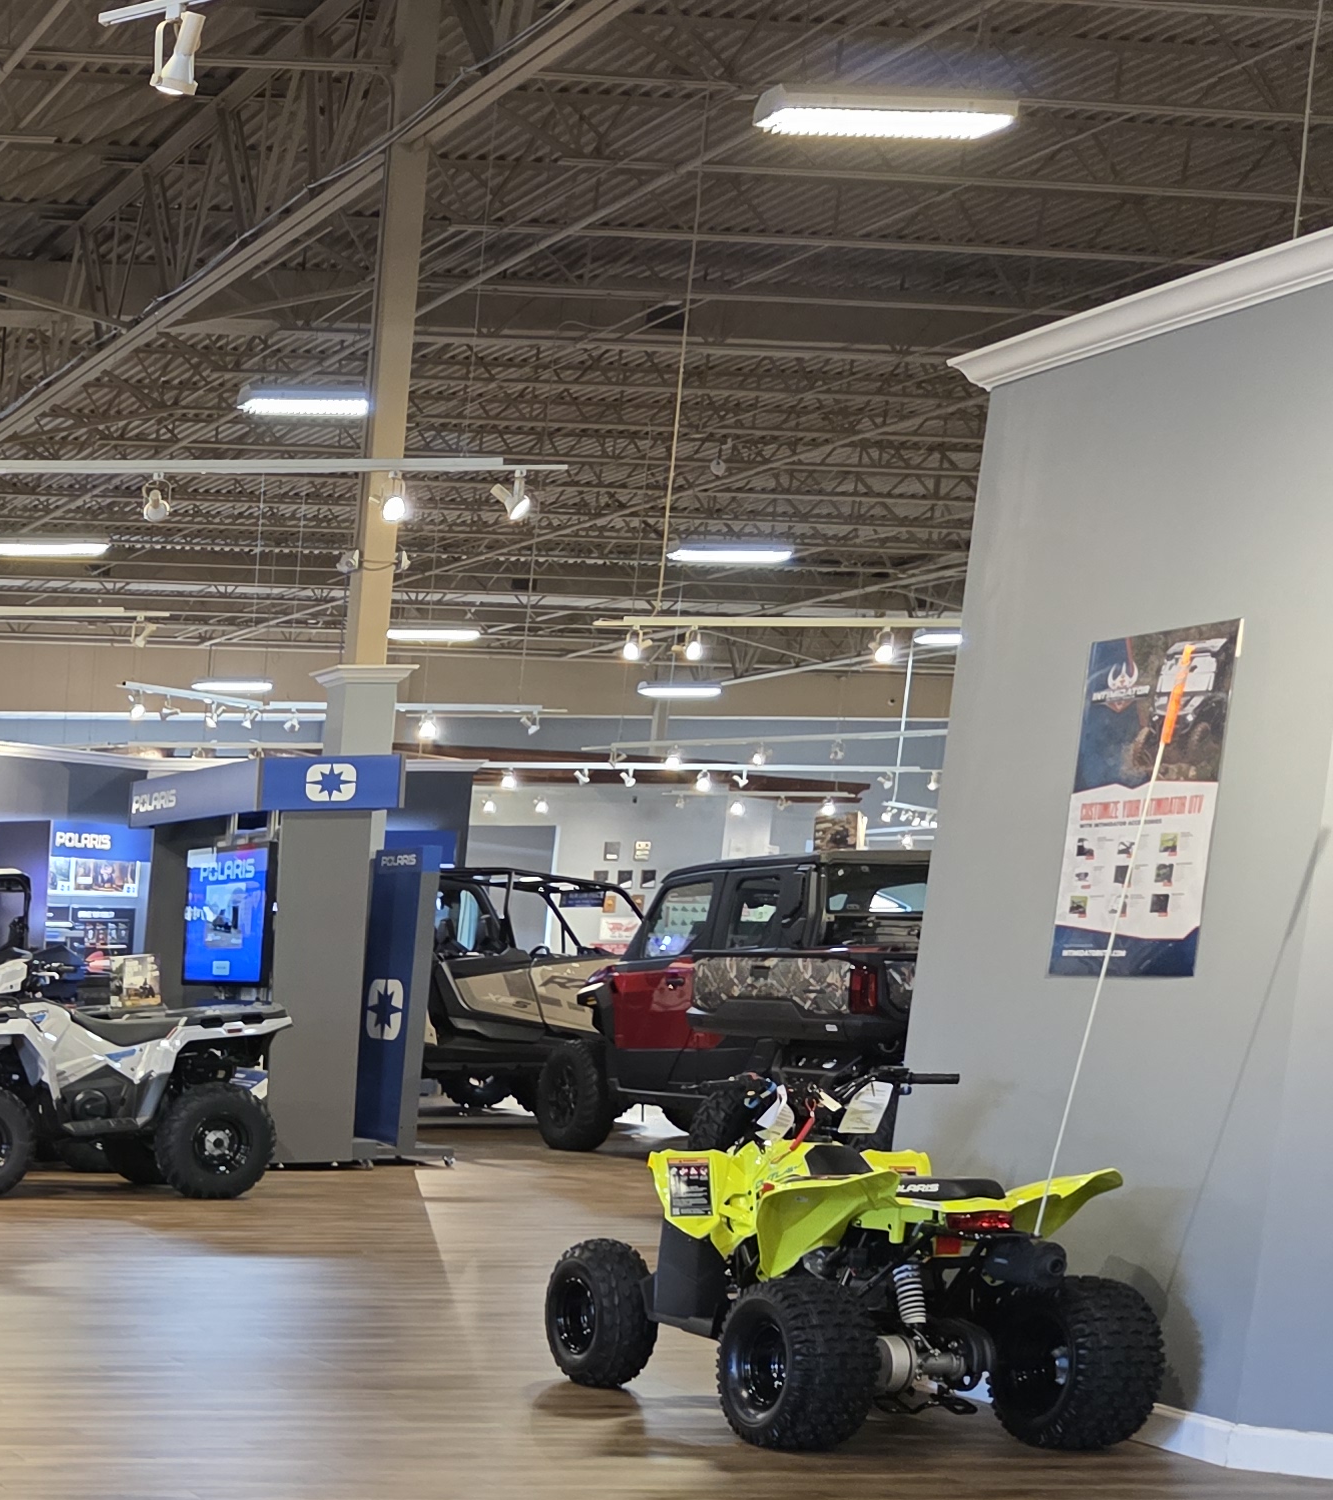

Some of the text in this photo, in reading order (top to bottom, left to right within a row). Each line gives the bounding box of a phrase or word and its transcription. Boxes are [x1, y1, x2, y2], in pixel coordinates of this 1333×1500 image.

[131, 789, 177, 814] POLARIS
[55, 831, 112, 850] POLARIS
[199, 858, 255, 882] POLARIS
[381, 853, 417, 867] POLARIS
